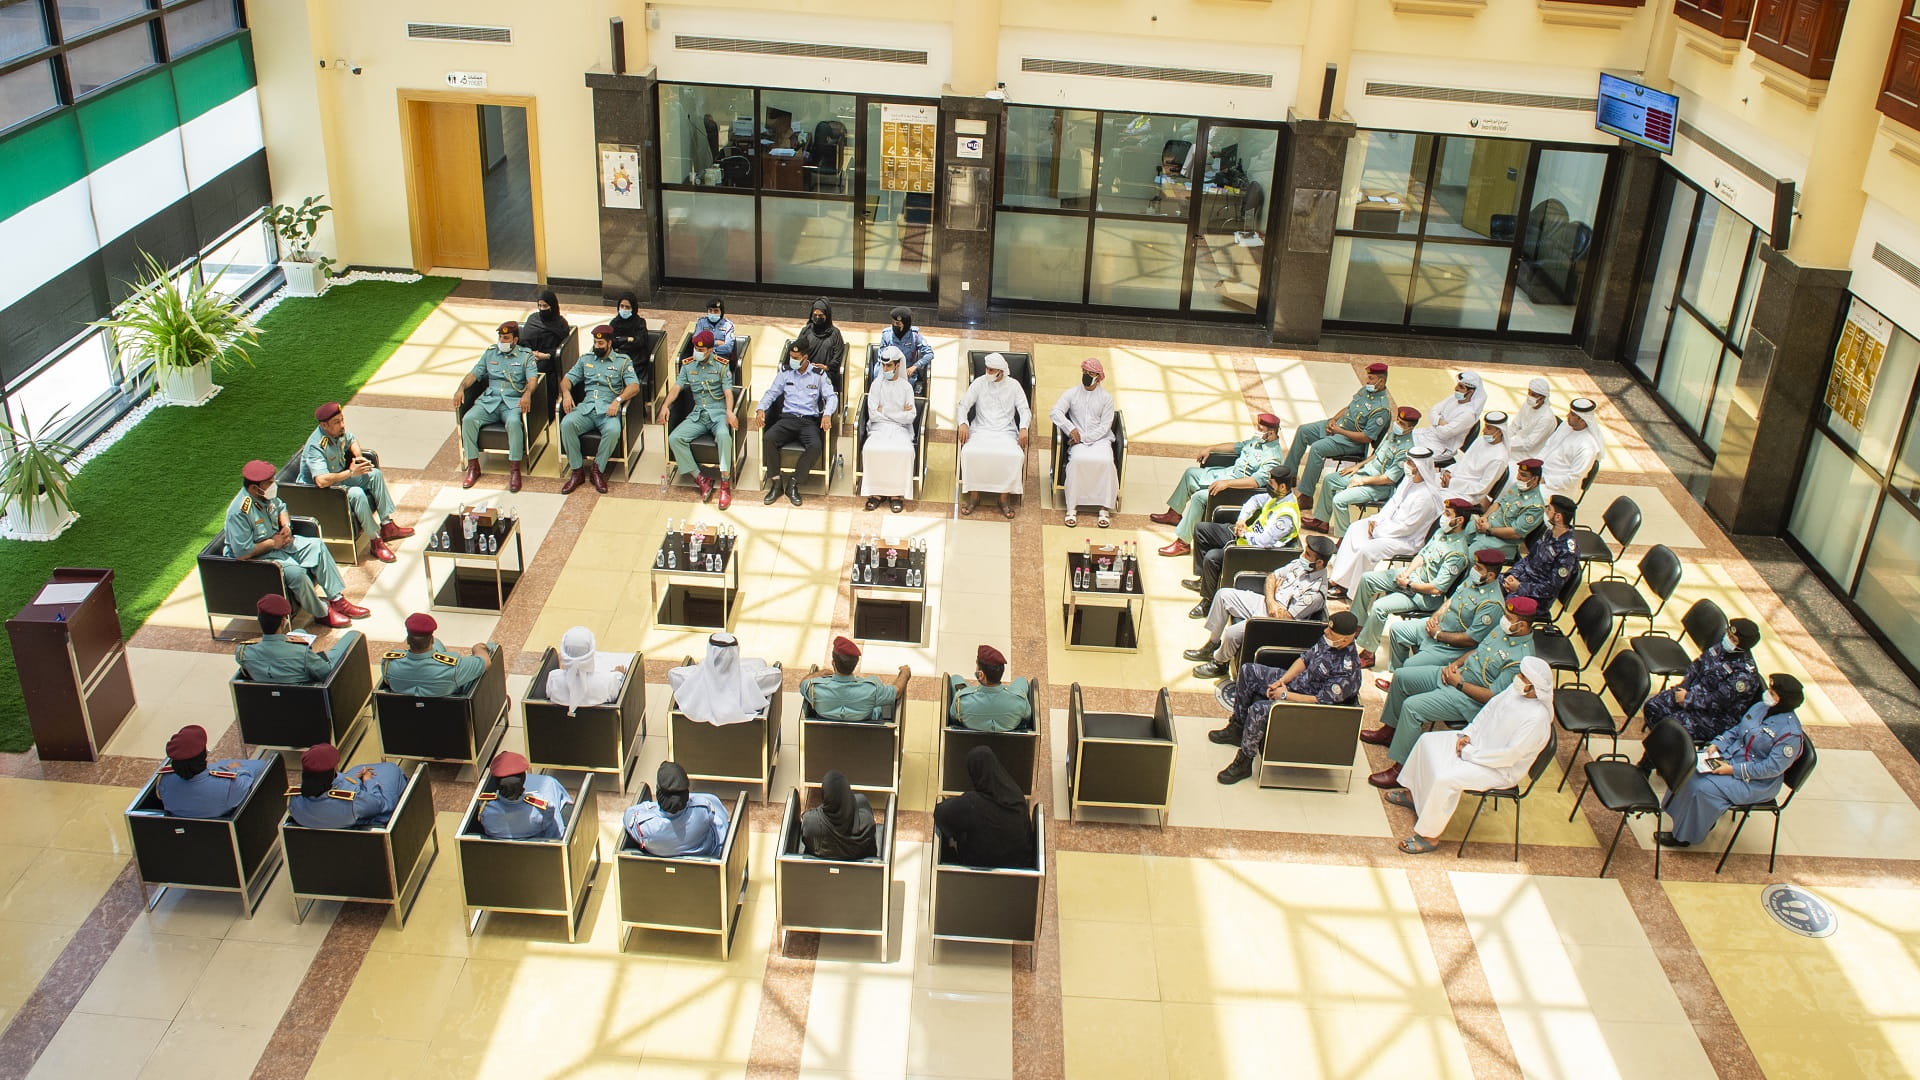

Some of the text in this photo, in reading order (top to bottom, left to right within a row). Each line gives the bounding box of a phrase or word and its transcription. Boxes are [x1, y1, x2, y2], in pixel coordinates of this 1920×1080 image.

[888, 146, 895, 155] 4
[902, 147, 908, 156] 3
[915, 148, 921, 157] 2
[887, 180, 933, 191] 8 7 6 5
